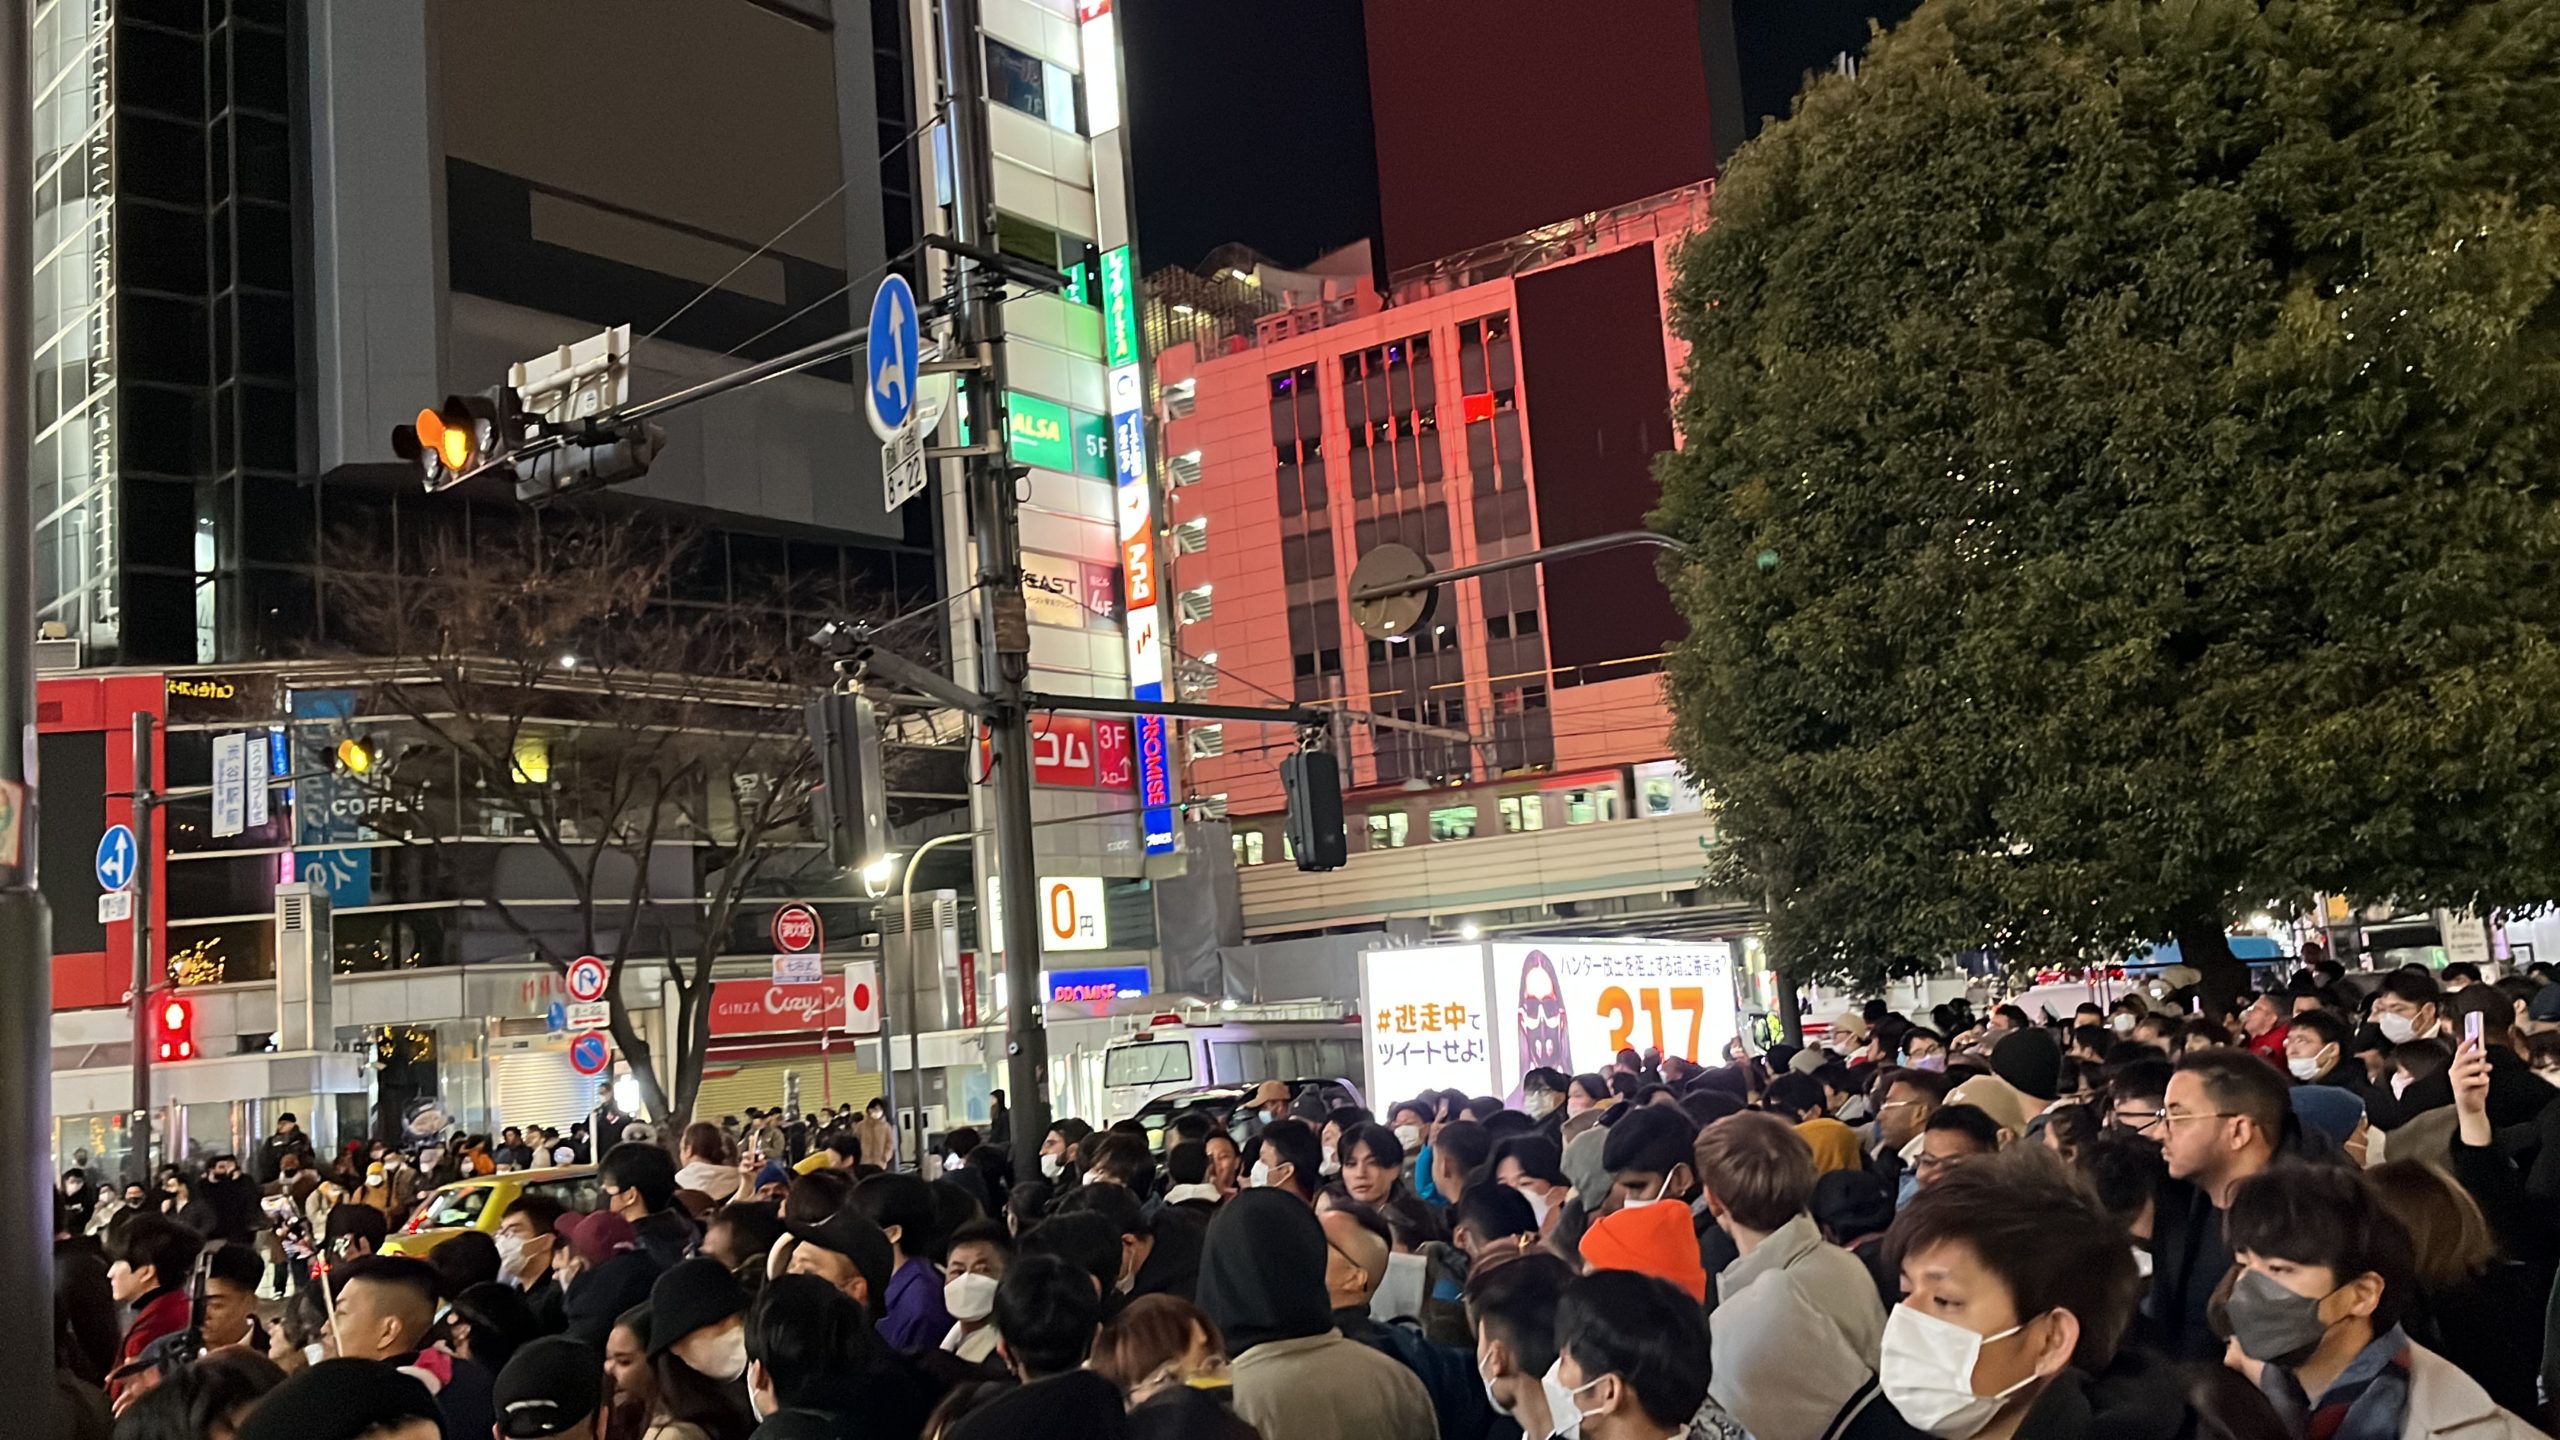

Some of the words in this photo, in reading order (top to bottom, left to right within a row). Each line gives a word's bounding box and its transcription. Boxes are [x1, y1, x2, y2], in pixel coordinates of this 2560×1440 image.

[1011, 412, 1061, 443] ALSA
[1085, 434, 1108, 459] 5F
[1128, 542, 1150, 601] アコム
[1090, 589, 1113, 617] 4F
[1099, 725, 1127, 750] 3F
[718, 1001, 761, 1016] GINZA
[765, 986, 826, 1023] Cozy
[1055, 983, 1117, 1002] PROMISE
[1597, 985, 1704, 1065] 317
